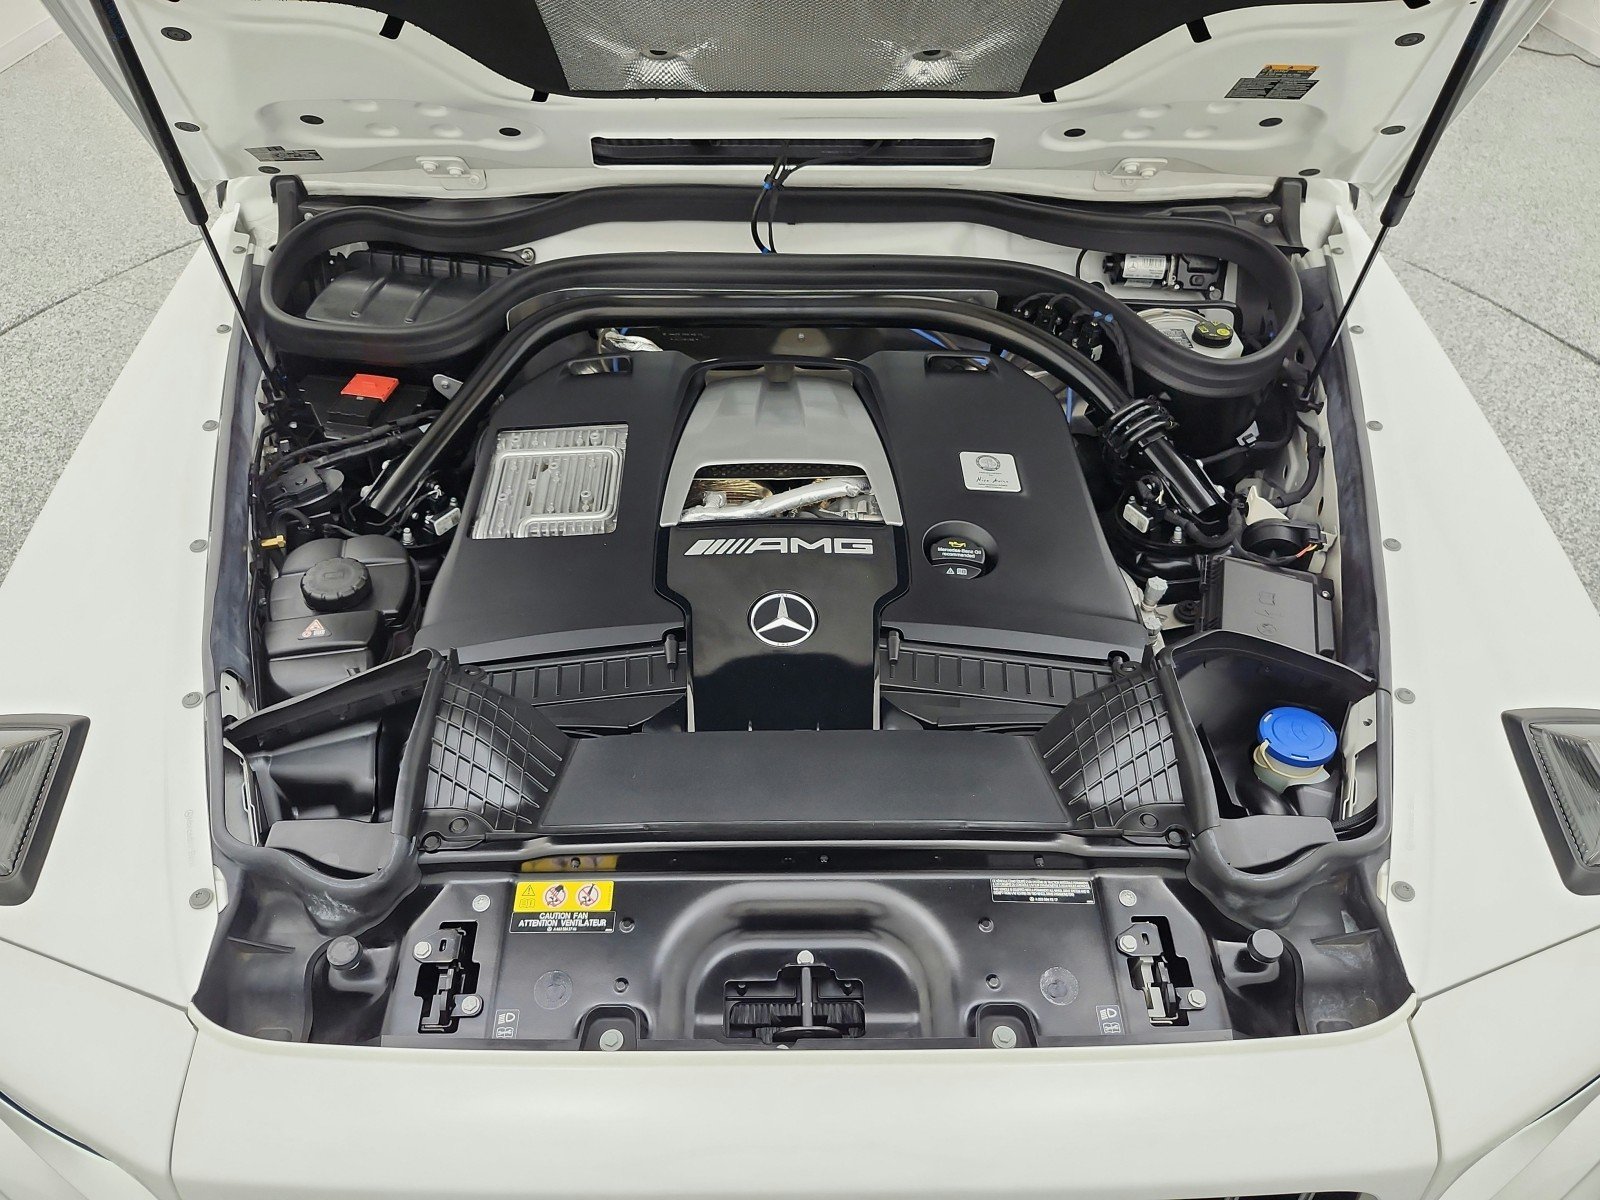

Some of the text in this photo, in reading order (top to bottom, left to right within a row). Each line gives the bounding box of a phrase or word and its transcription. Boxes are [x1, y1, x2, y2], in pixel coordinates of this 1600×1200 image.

[744, 537, 874, 555] AMG
[937, 546, 974, 554] Mercedes-Benz
[518, 919, 607, 927] ATTENTION VENTILATEUR
